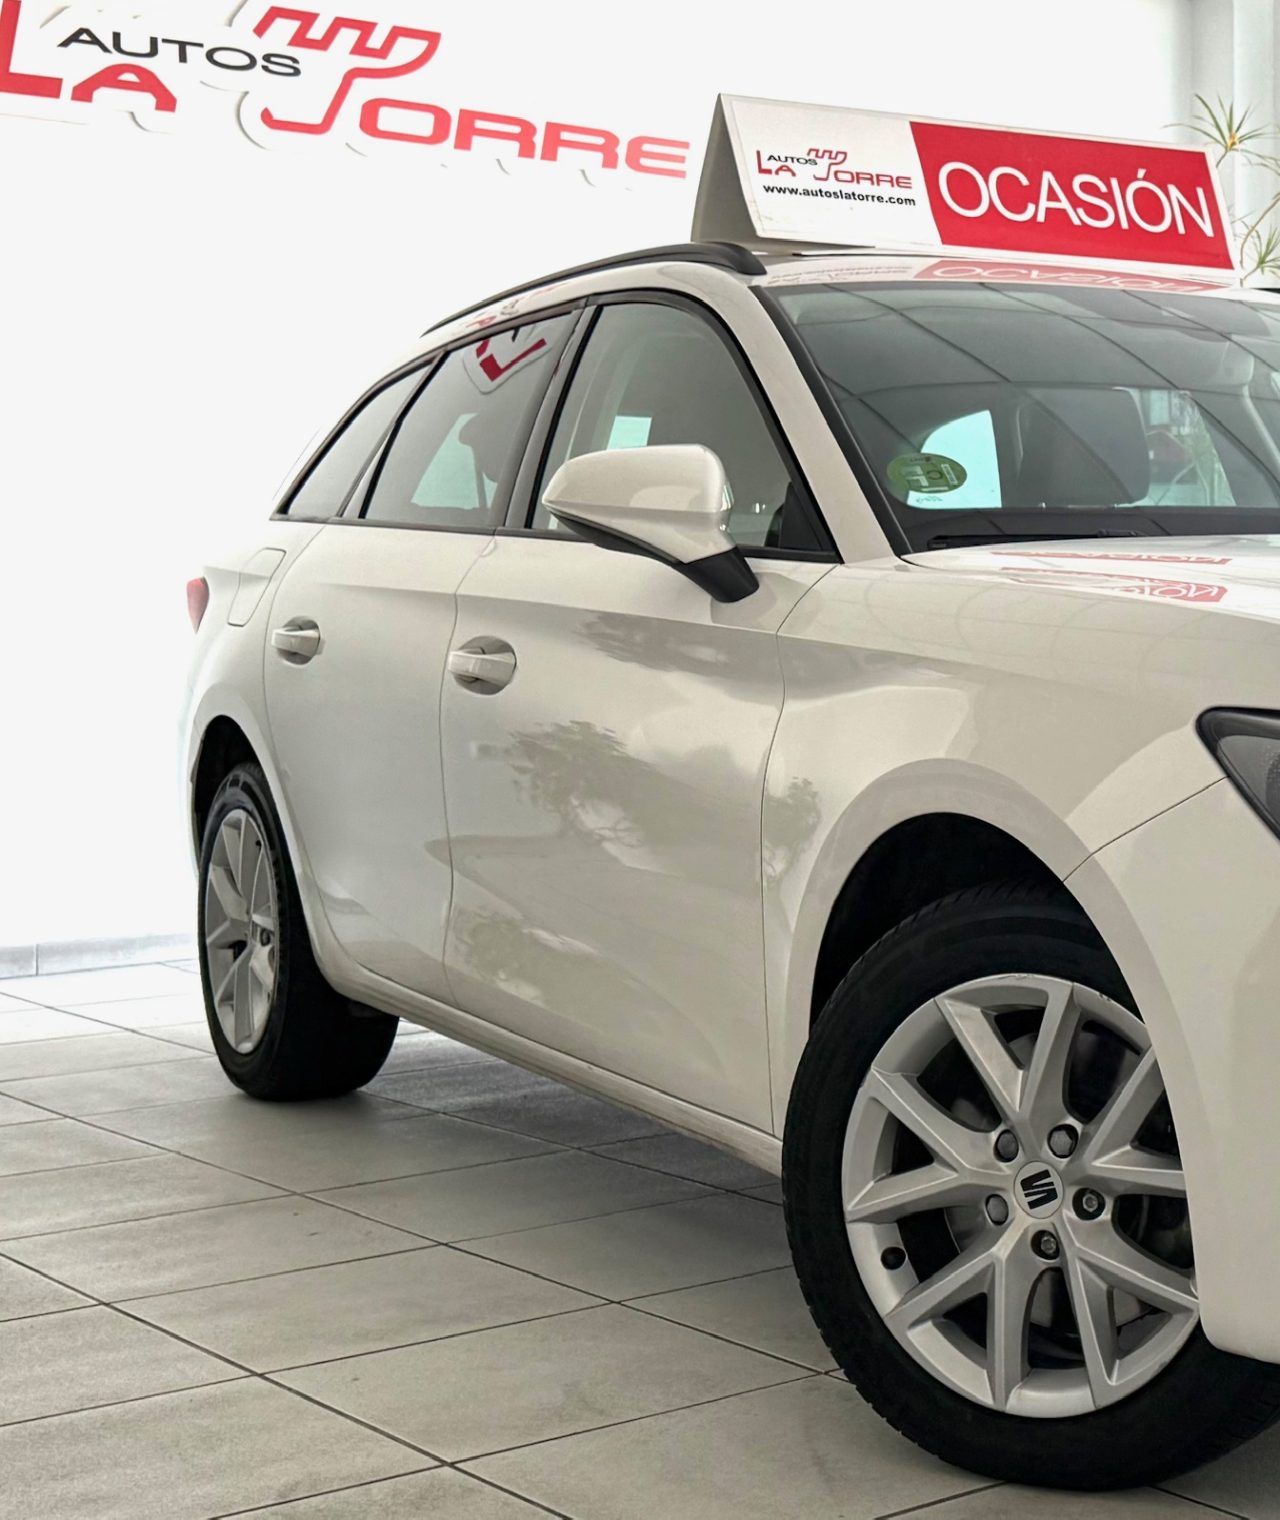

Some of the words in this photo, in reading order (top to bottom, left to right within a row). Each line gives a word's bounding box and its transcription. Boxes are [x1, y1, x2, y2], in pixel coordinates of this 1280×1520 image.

[57, 26, 302, 78] AUTOS
[0, 0, 177, 112] LA
[252, 5, 691, 180] TORRE
[756, 150, 797, 177] LA
[807, 148, 912, 189] TORRE
[767, 154, 818, 166] AUTOS
[763, 185, 916, 206] www.autoslatorre.com
[938, 168, 1214, 237] OCASIÓN
